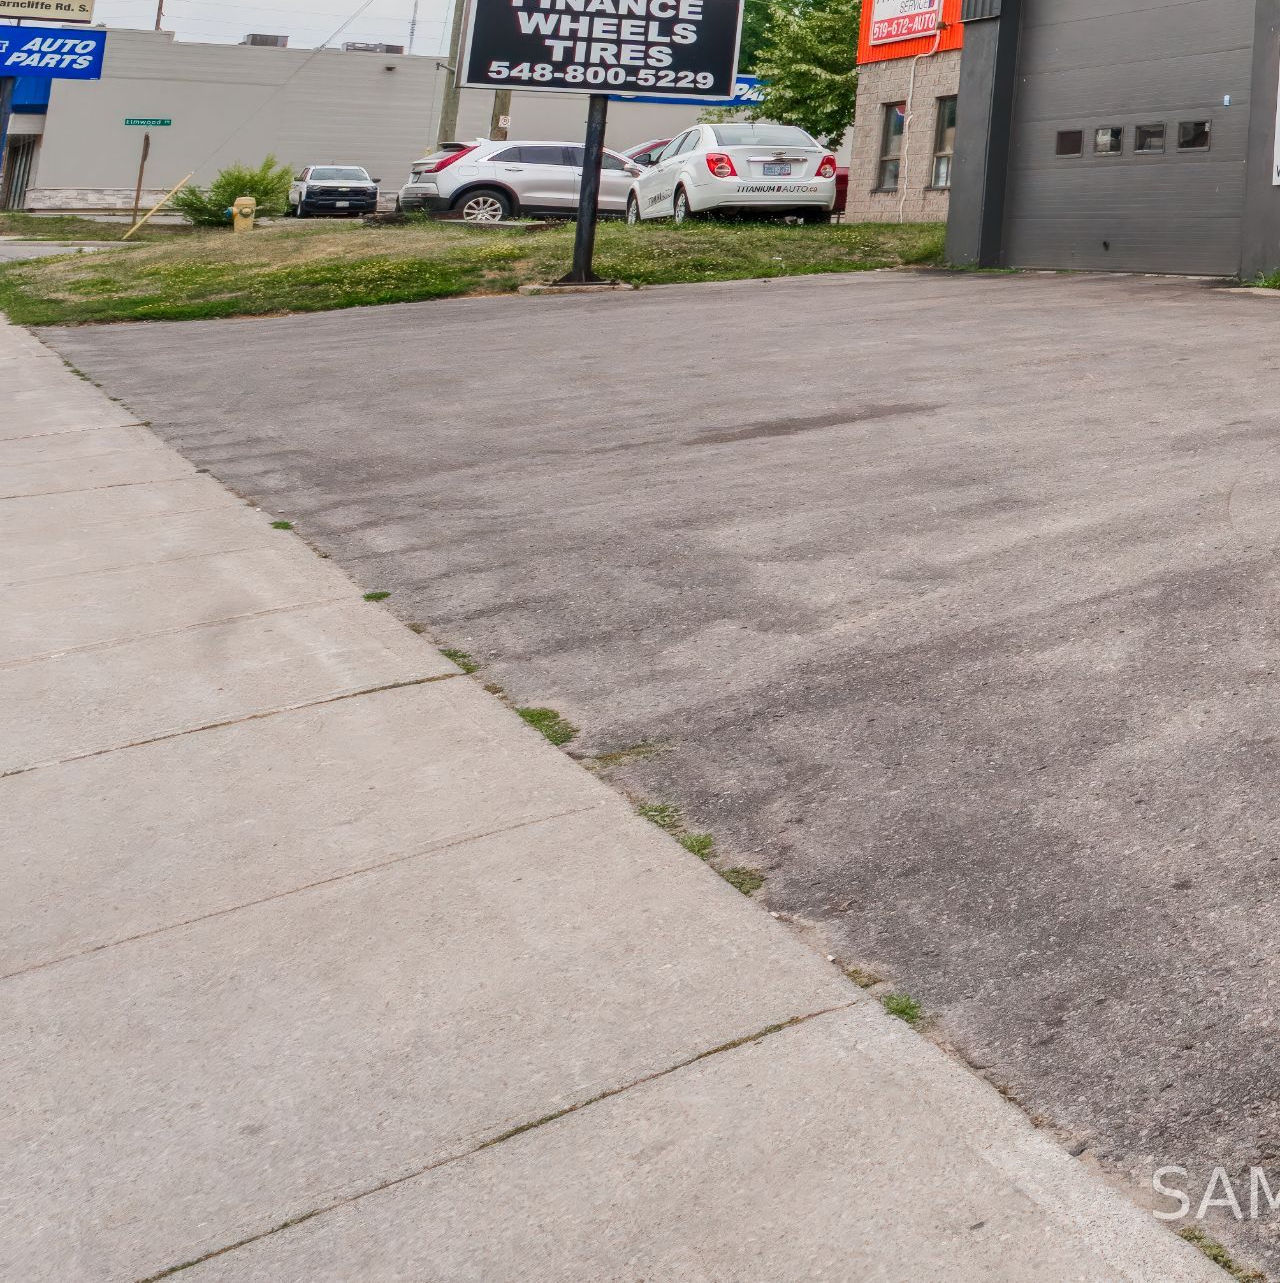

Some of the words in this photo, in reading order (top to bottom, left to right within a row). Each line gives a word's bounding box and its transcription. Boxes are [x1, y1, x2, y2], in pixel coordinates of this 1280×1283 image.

[55, 2, 75, 12] Rd.
[78, 4, 89, 13] S.
[517, 11, 698, 45] WHEELS
[873, 12, 936, 39] 519-672-AUTO
[20, 37, 97, 54] AUTO
[543, 38, 673, 68] TIRES
[4, 51, 94, 70] PARTS
[487, 60, 715, 89] 548-800-5229
[737, 185, 776, 193] TITANIUM
